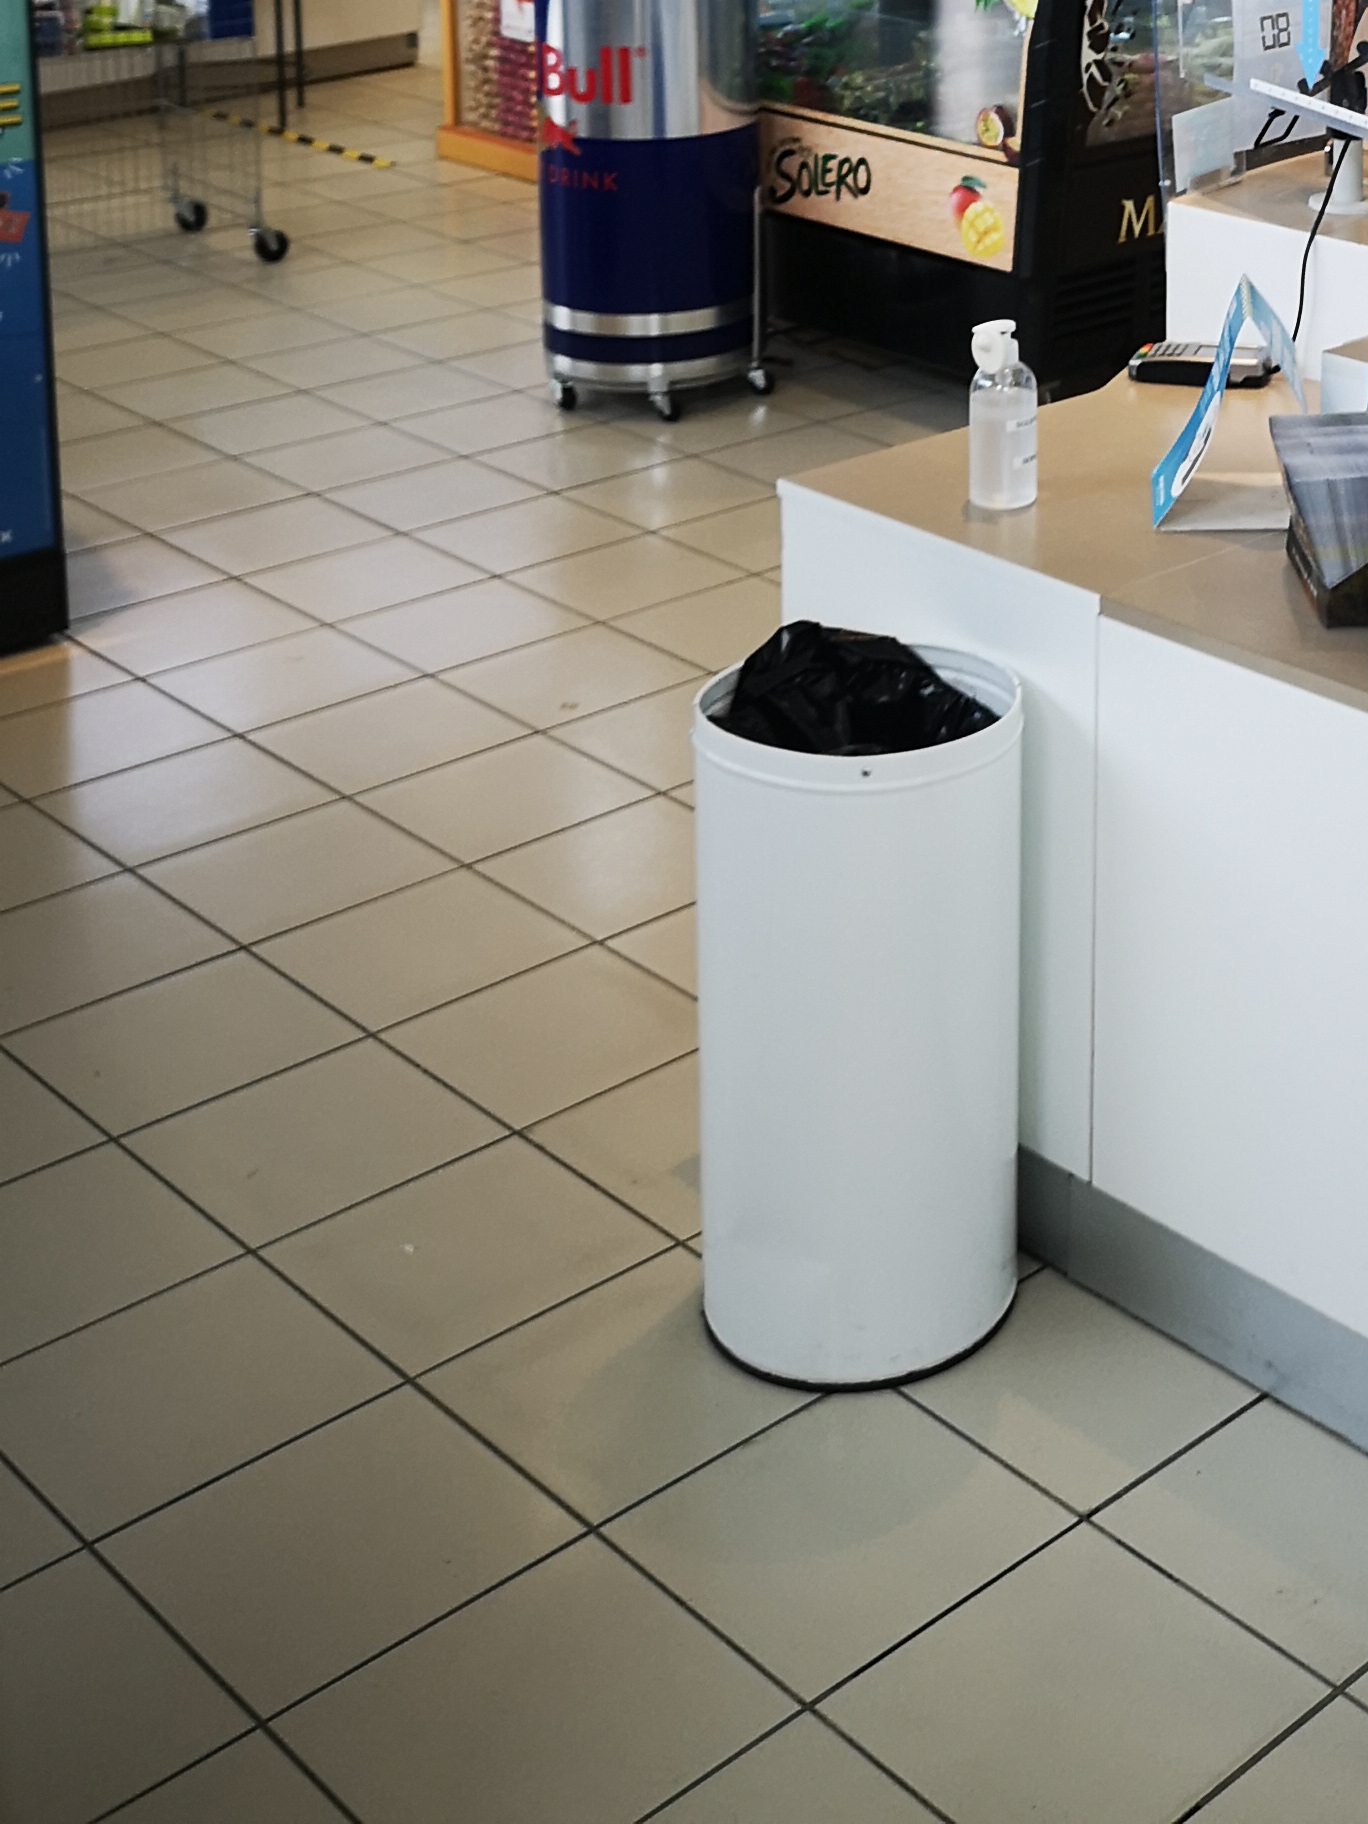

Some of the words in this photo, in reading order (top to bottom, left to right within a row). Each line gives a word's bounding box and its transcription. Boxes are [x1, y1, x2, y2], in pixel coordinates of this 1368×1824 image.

[541, 42, 633, 105] Bull
[548, 164, 618, 191] DRINK
[768, 148, 872, 205] SOLERO
